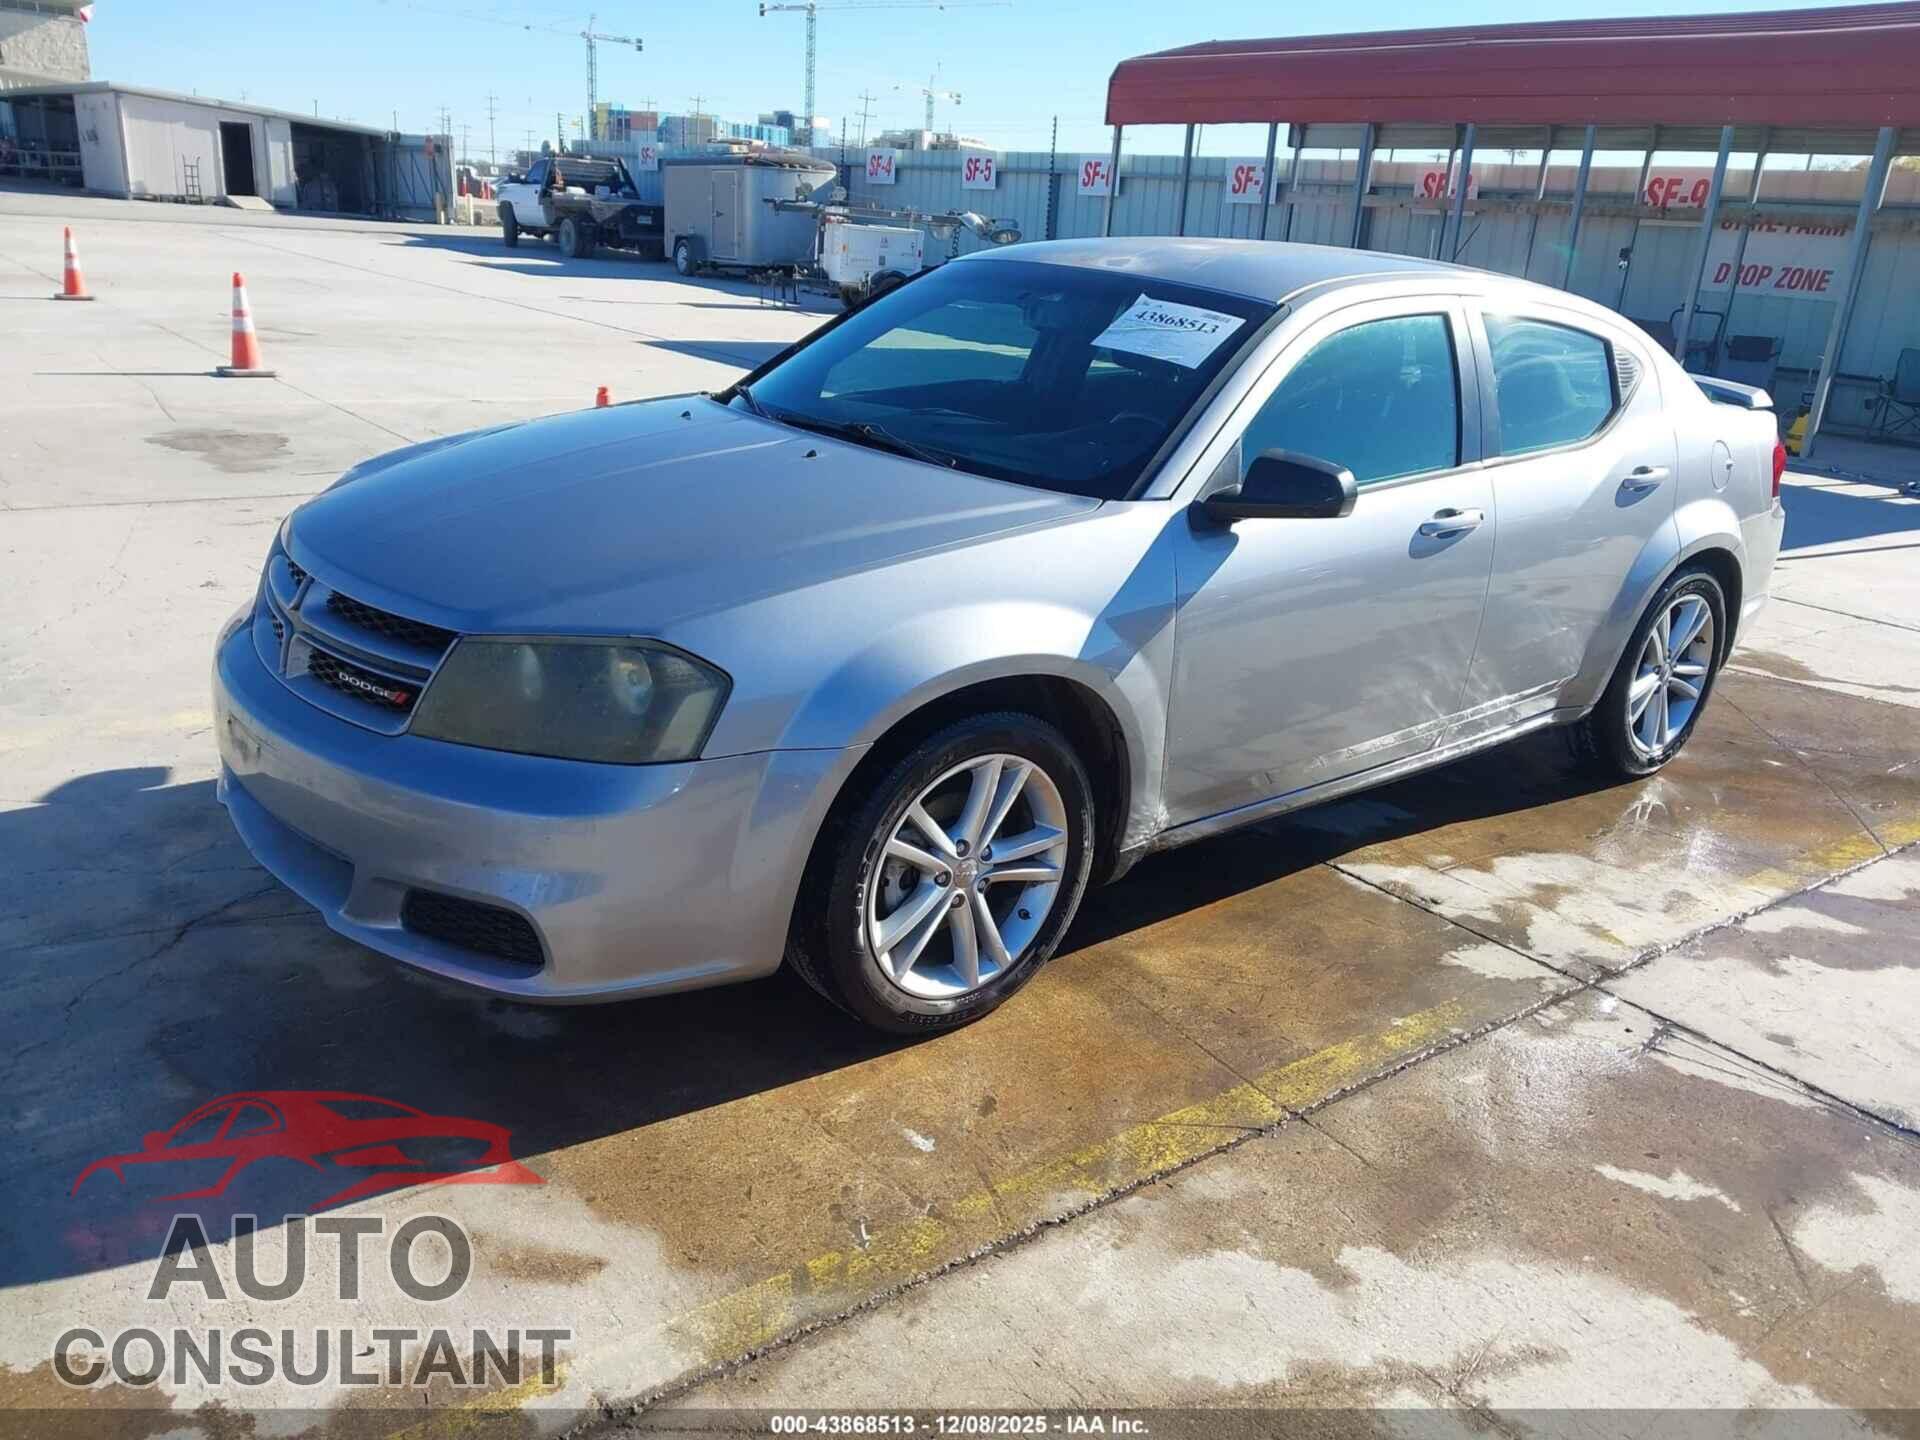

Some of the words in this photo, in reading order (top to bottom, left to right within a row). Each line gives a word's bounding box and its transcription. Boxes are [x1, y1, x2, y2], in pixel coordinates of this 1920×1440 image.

[868, 155, 892, 177] SF-4
[965, 158, 992, 181] SF-5
[1423, 172, 1473, 199] SF-
[1647, 177, 1710, 209] SF-9
[1774, 266, 1834, 292] ZONE
[1135, 310, 1220, 335] 43868513
[338, 671, 399, 701] DODGE
